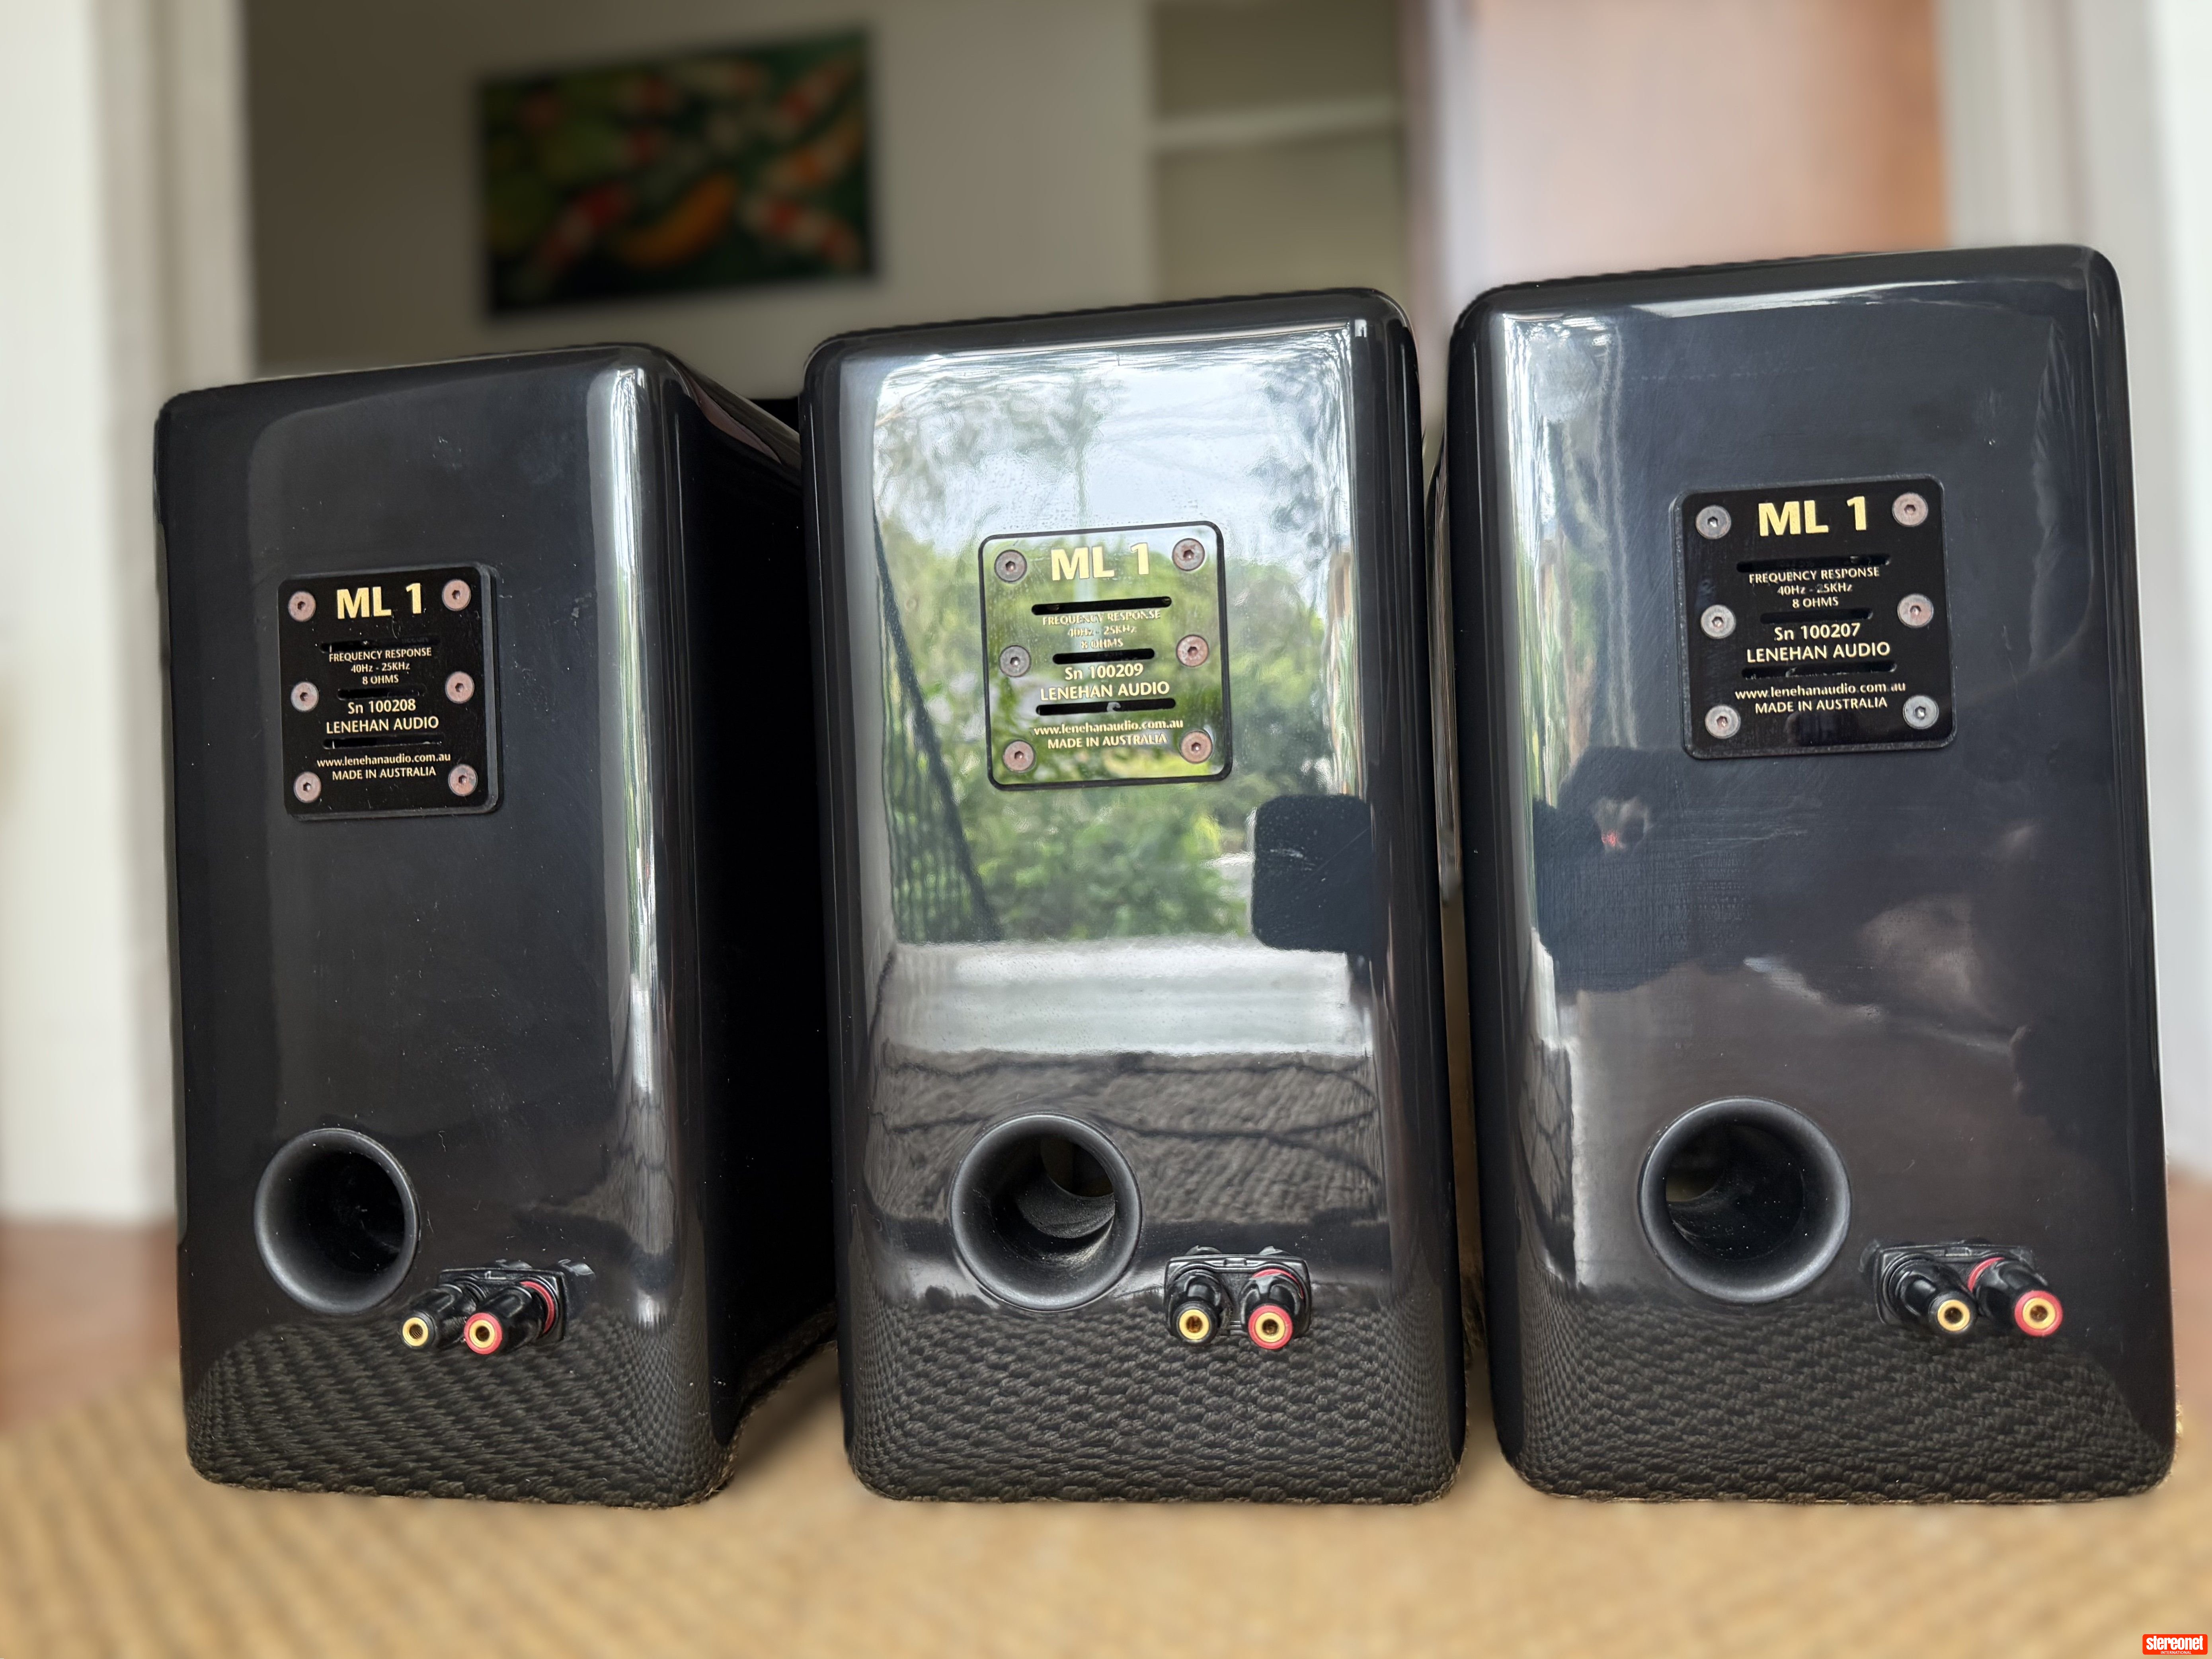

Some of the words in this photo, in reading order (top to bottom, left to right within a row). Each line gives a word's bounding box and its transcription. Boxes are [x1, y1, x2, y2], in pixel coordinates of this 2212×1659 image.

[1758, 500, 1829, 536] ML
[1847, 496, 1867, 531] 1
[1051, 546, 1114, 581] ML
[1130, 543, 1149, 575] 1
[1749, 571, 1817, 584] FREQUENCY
[1821, 567, 1880, 579] RESPONSE
[1777, 585, 1805, 595] 40Hz
[337, 587, 392, 619] ML
[406, 583, 422, 614] 1
[1793, 599, 1799, 608] 8
[1802, 597, 1839, 607] OHMS
[1043, 613, 1103, 626] FREQUENCY
[1107, 610, 1161, 621] RESPONSE
[1068, 627, 1093, 637] 40Hz
[1103, 625, 1137, 635] 25KHz
[1774, 627, 1794, 641] Sn
[1800, 623, 1861, 639] 100207
[1081, 639, 1088, 649] 8
[1090, 638, 1123, 648] OHMS
[329, 650, 382, 662] FREQUENCY
[385, 647, 431, 659] RESPONSE
[1747, 645, 1827, 663] LENEHAN
[1833, 641, 1890, 658] AUDIO
[351, 663, 373, 673] 40Hz
[382, 662, 410, 671] 25KHz
[1065, 667, 1083, 680] Sn
[1090, 663, 1143, 678] 100209
[363, 676, 368, 685] 8
[371, 675, 399, 684] OHMS
[1040, 684, 1112, 701] LENEHAN
[1118, 681, 1169, 696] AUDIO
[348, 702, 363, 715] Sn
[369, 699, 416, 713] 100208
[1755, 701, 1793, 714] MADE
[1798, 701, 1812, 711] IN
[1816, 697, 1888, 711] AUSTRALIA
[326, 719, 388, 734] LENEHAN
[394, 716, 439, 731] AUDIO
[1034, 719, 1183, 734] www.lenehanaudio.com.au
[1048, 737, 1082, 749] MADE
[1086, 737, 1099, 747] IN
[1102, 733, 1167, 746] AUSTRALIA
[317, 753, 451, 767] www.lenehanaudio.com.au
[332, 769, 362, 780] MADE
[366, 769, 376, 778] IN
[380, 766, 436, 778] AUSTRALIA
